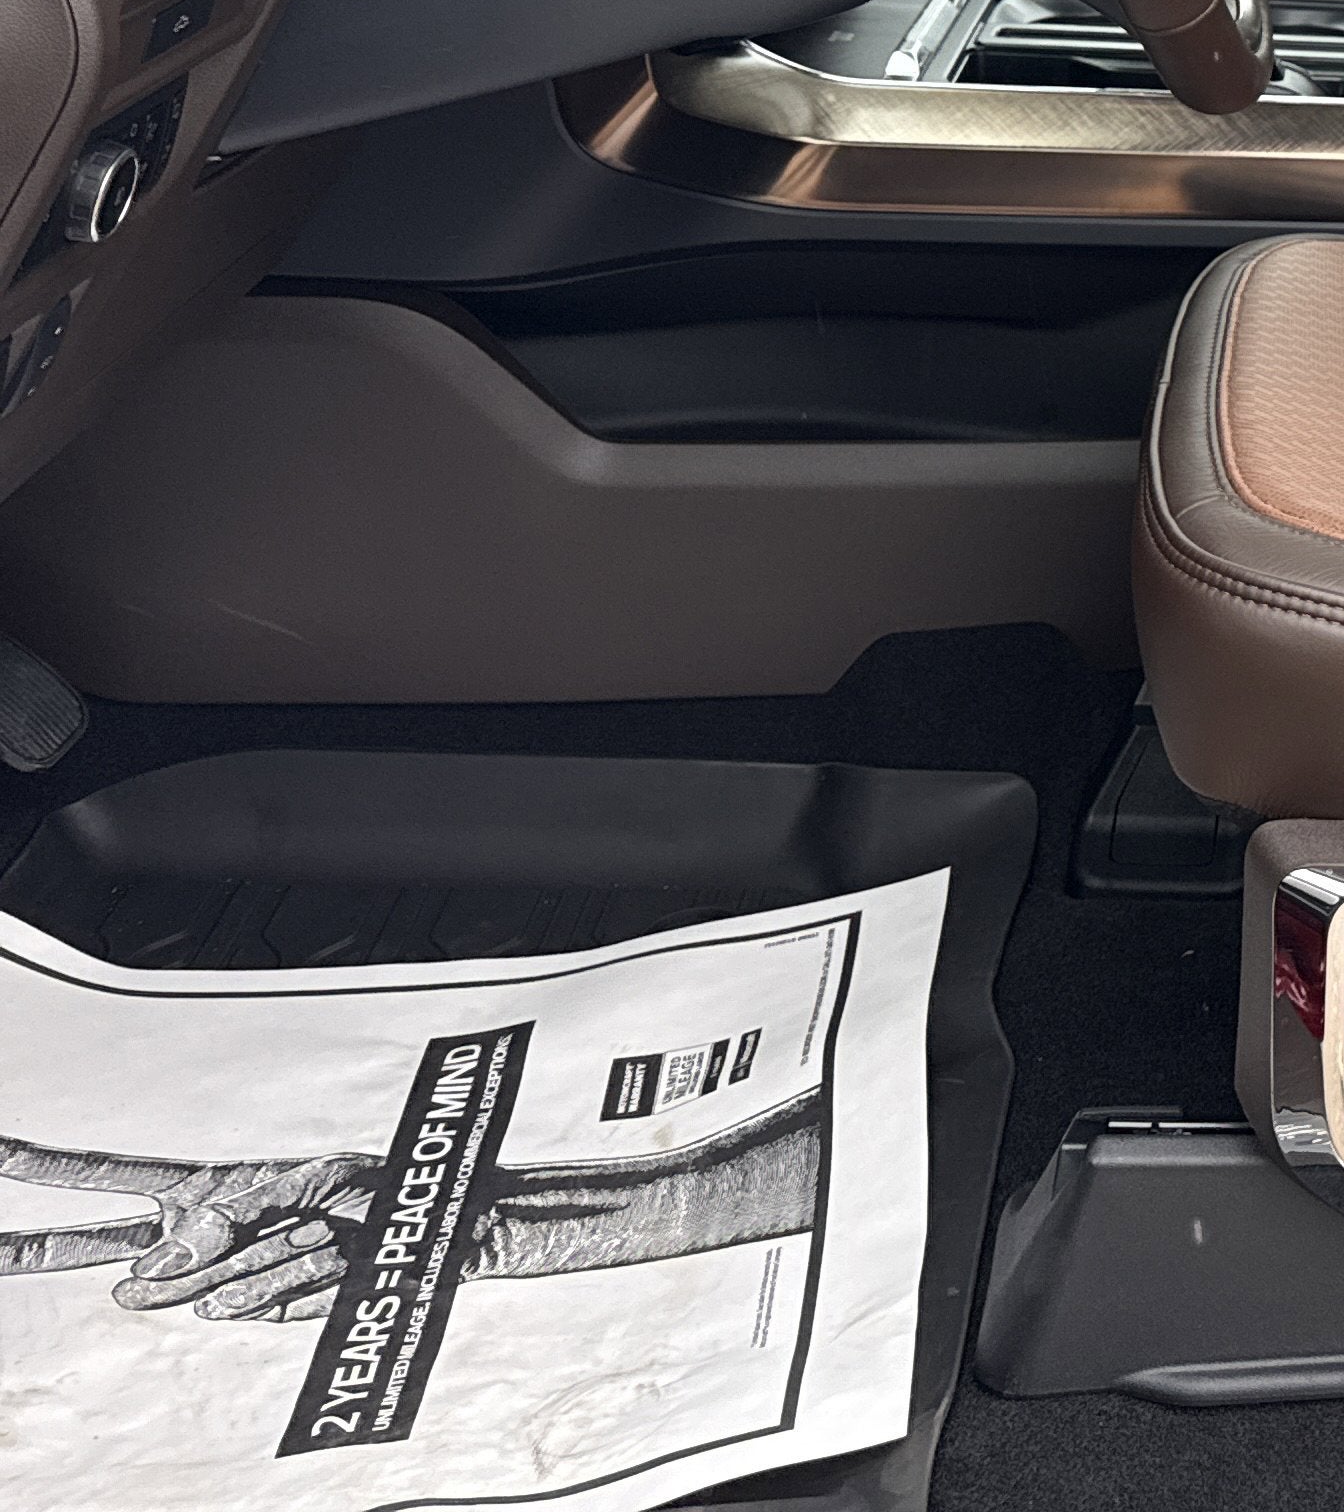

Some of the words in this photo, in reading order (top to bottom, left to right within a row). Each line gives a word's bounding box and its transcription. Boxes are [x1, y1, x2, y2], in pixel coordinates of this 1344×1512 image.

[426, 1043, 482, 1119] MIND
[627, 1062, 648, 1113] WARRANTY
[662, 1056, 682, 1105] UNLIMITED
[674, 1053, 697, 1100] MILEAGE
[408, 1119, 461, 1163] OF
[455, 1108, 493, 1179] COMMERCIAL
[373, 1162, 447, 1266] PEACE
[449, 1179, 470, 1197] NO
[415, 1240, 450, 1301] INCLUDES
[319, 1293, 403, 1411] YEARS
[370, 1359, 412, 1431] UNLIMITED
[308, 1410, 362, 1437] 2
